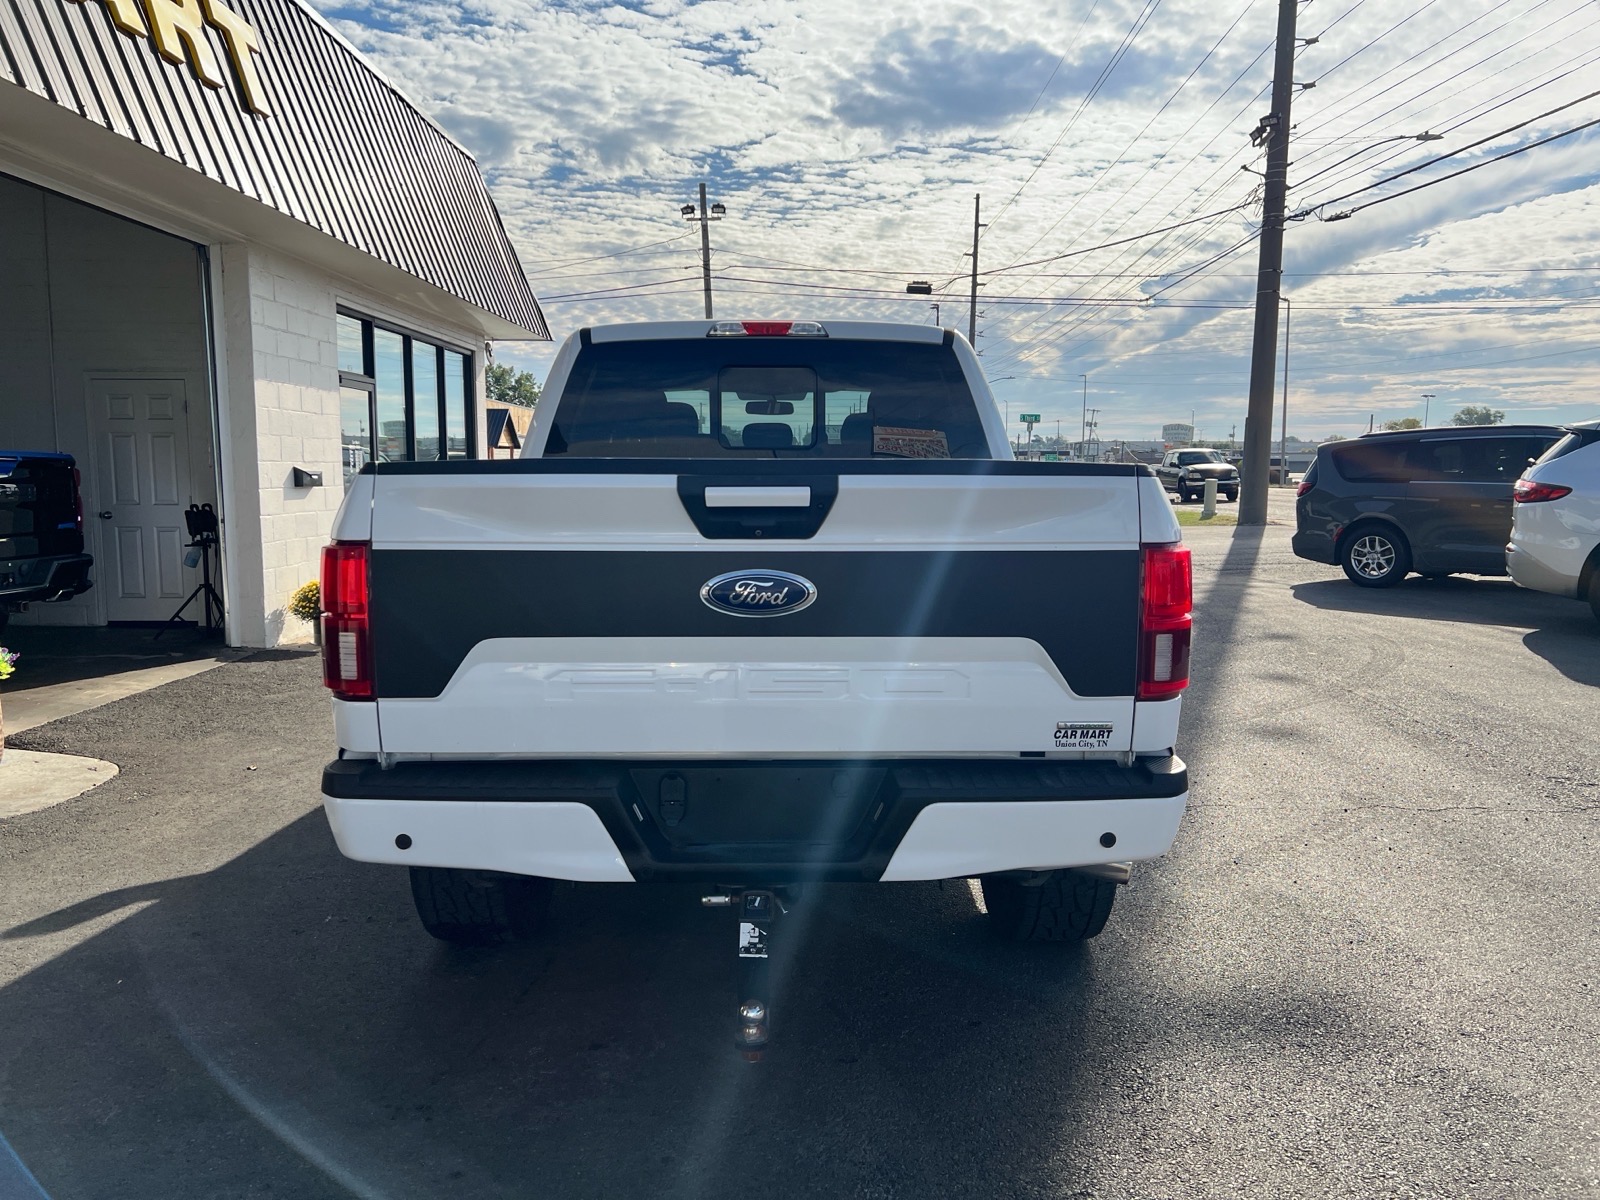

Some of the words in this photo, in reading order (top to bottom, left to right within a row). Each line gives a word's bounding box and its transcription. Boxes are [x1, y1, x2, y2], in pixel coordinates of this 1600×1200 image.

[65, 0, 271, 119] RT
[729, 580, 789, 605] Ford
[1054, 730, 1078, 739] CAR
[1080, 730, 1112, 739] MART
[1078, 740, 1095, 749] City,
